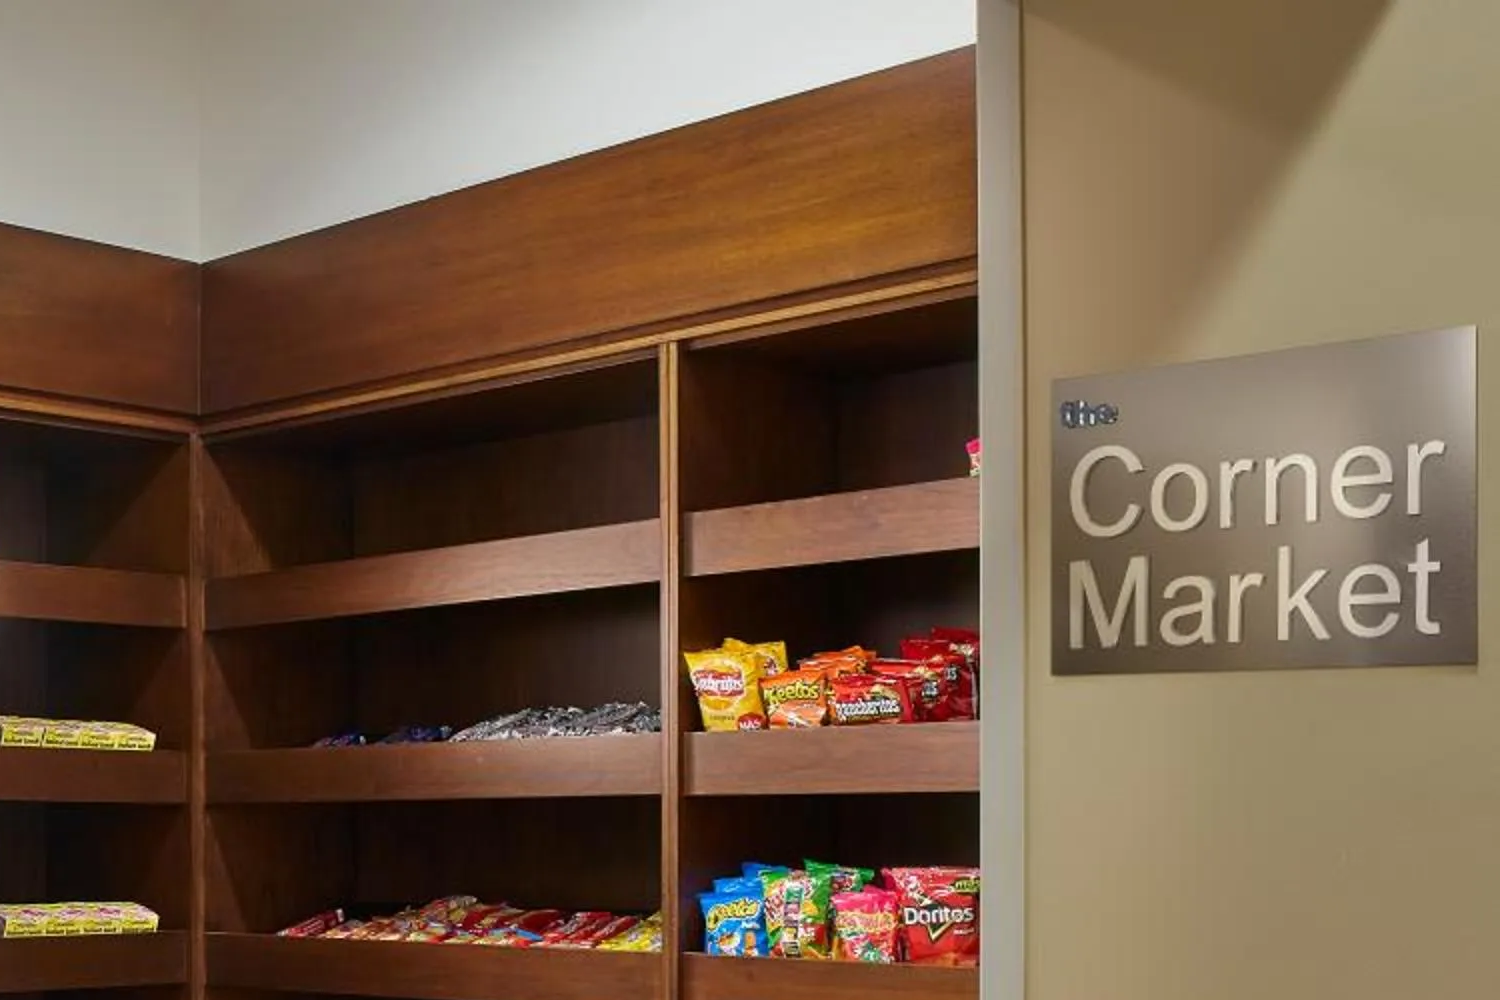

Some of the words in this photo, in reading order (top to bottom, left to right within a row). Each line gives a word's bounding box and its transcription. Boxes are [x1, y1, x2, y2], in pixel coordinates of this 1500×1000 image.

[1061, 400, 1118, 428] the
[1069, 439, 1446, 538] Corner
[1068, 538, 1441, 650] Market
[904, 906, 974, 925] Doritos
